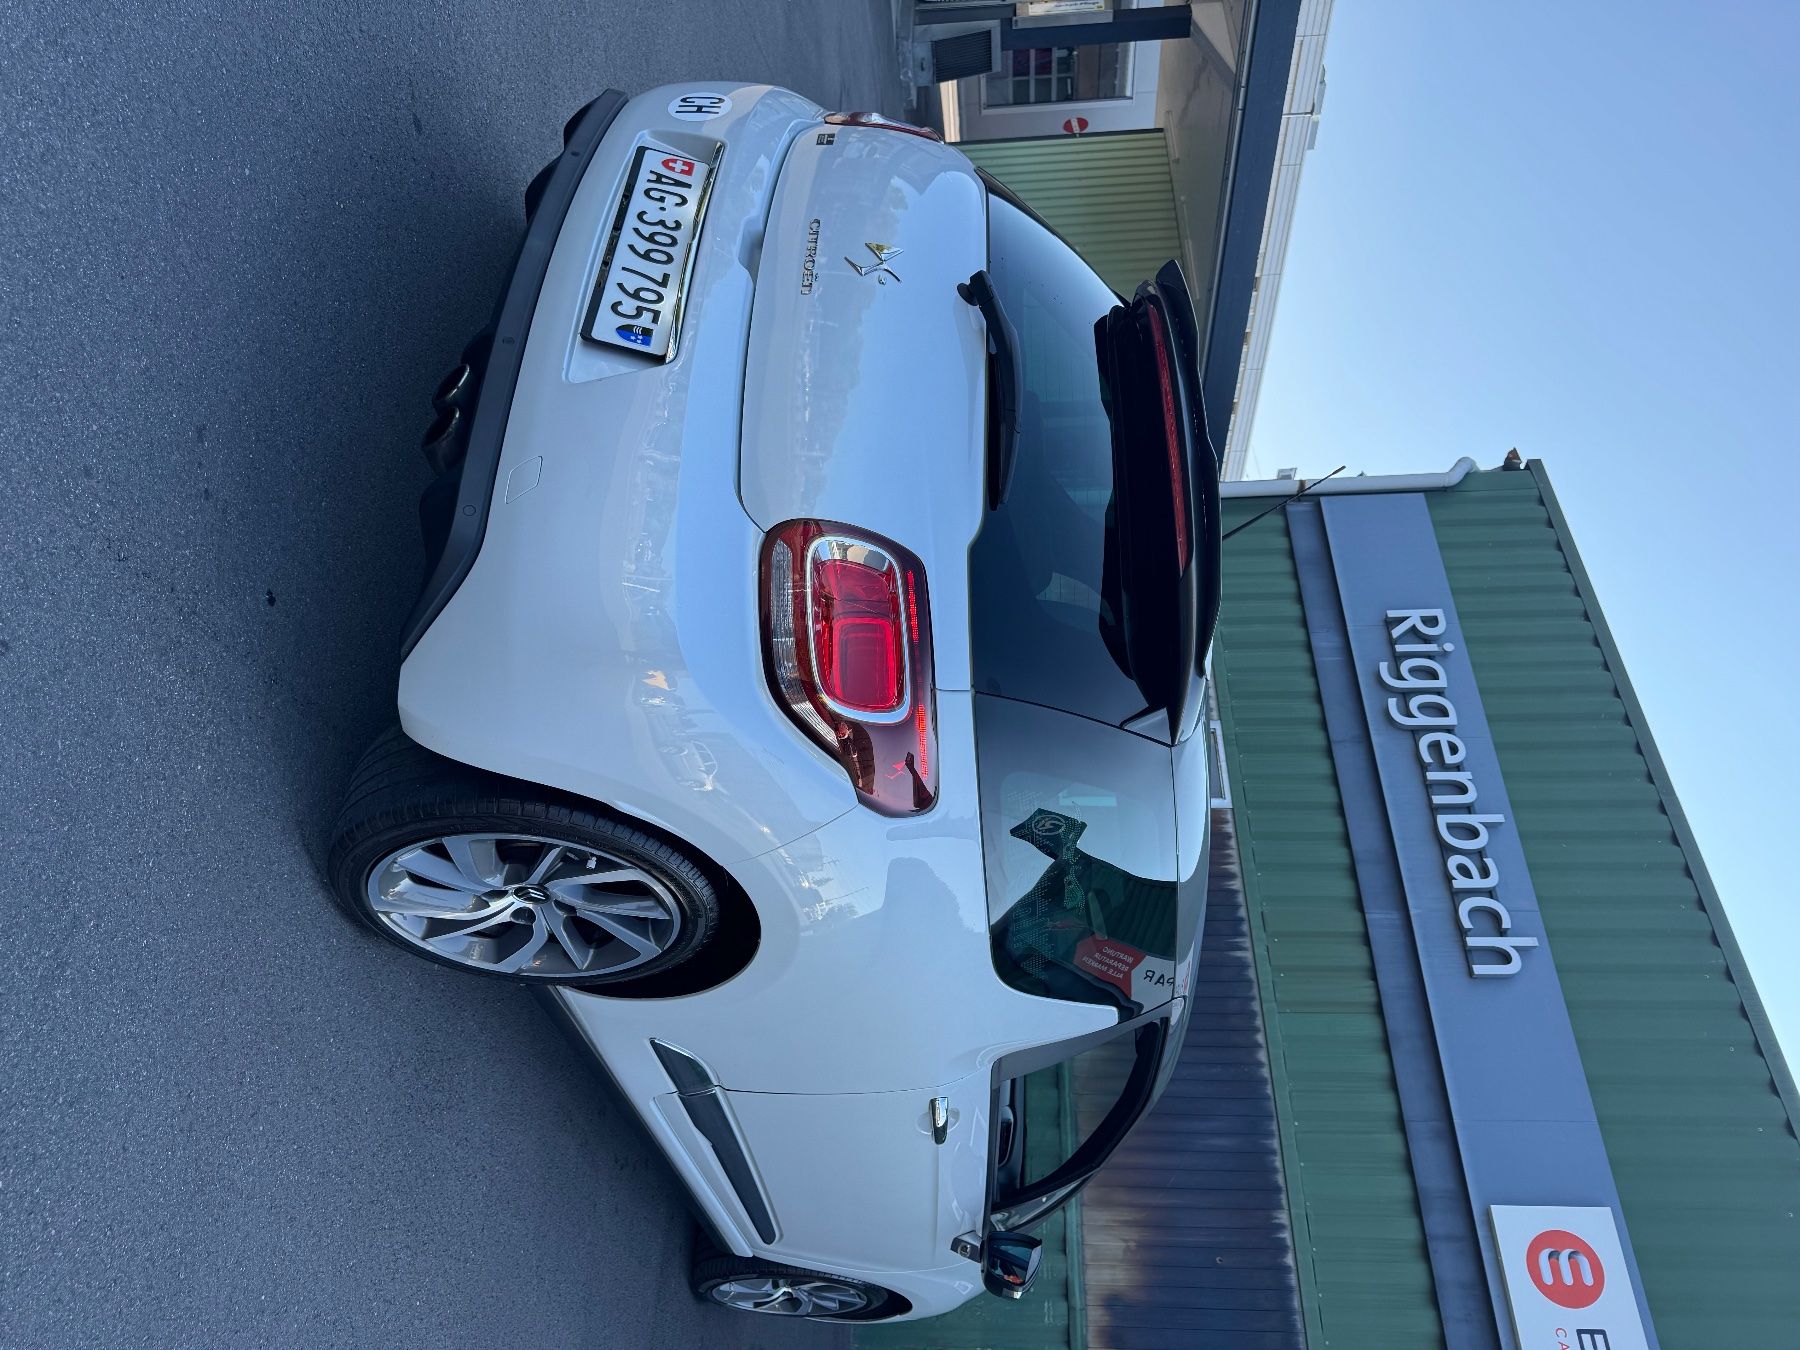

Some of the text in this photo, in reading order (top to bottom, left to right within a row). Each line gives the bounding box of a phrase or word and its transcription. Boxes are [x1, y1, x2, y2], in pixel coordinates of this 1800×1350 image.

[675, 97, 726, 115] CH
[801, 218, 820, 295] CITROËN
[1379, 608, 1540, 978] Riggenbach
